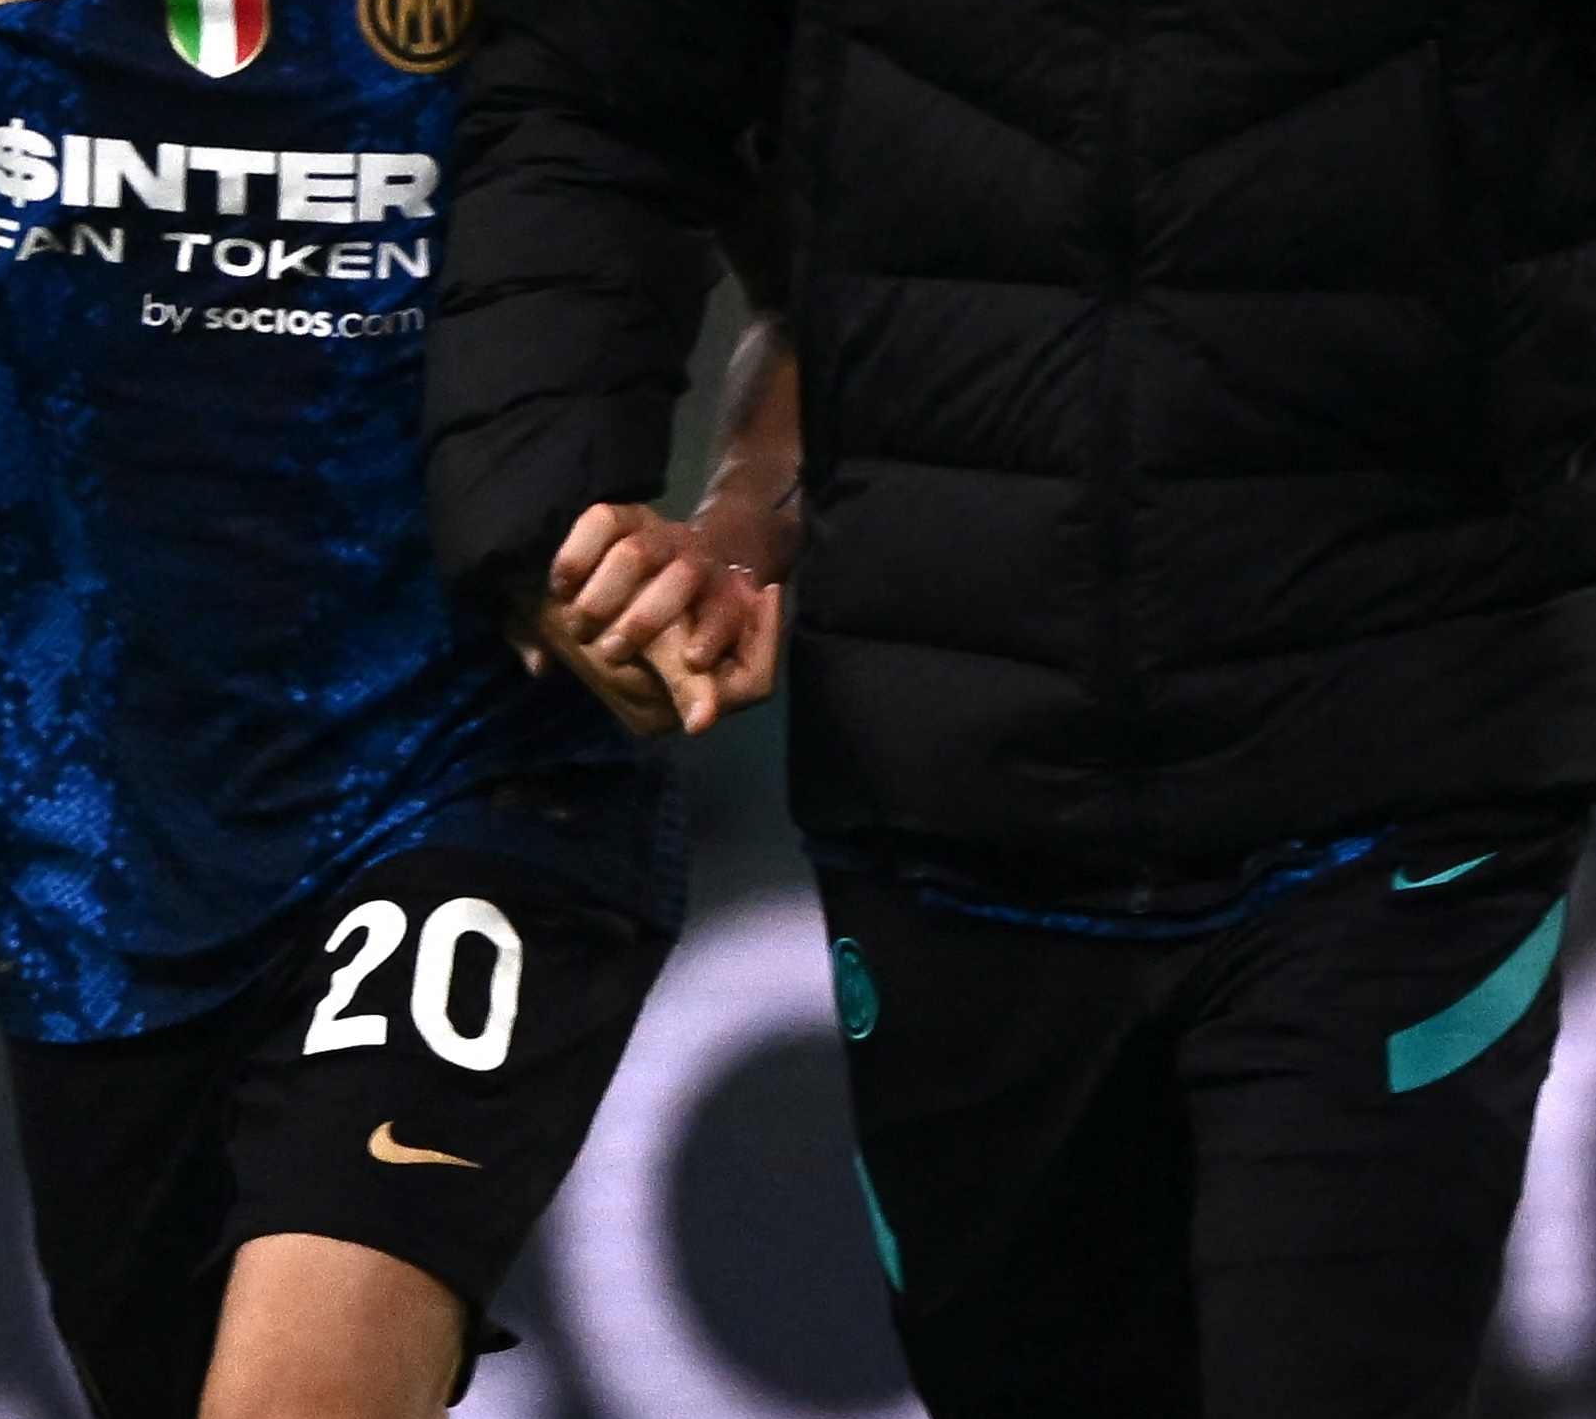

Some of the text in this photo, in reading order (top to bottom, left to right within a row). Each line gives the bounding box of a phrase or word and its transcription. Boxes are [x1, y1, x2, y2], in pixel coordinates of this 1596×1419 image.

[161, 231, 431, 281] TOKEN
[141, 291, 426, 339] by socios.com
[301, 895, 524, 1073] 20
